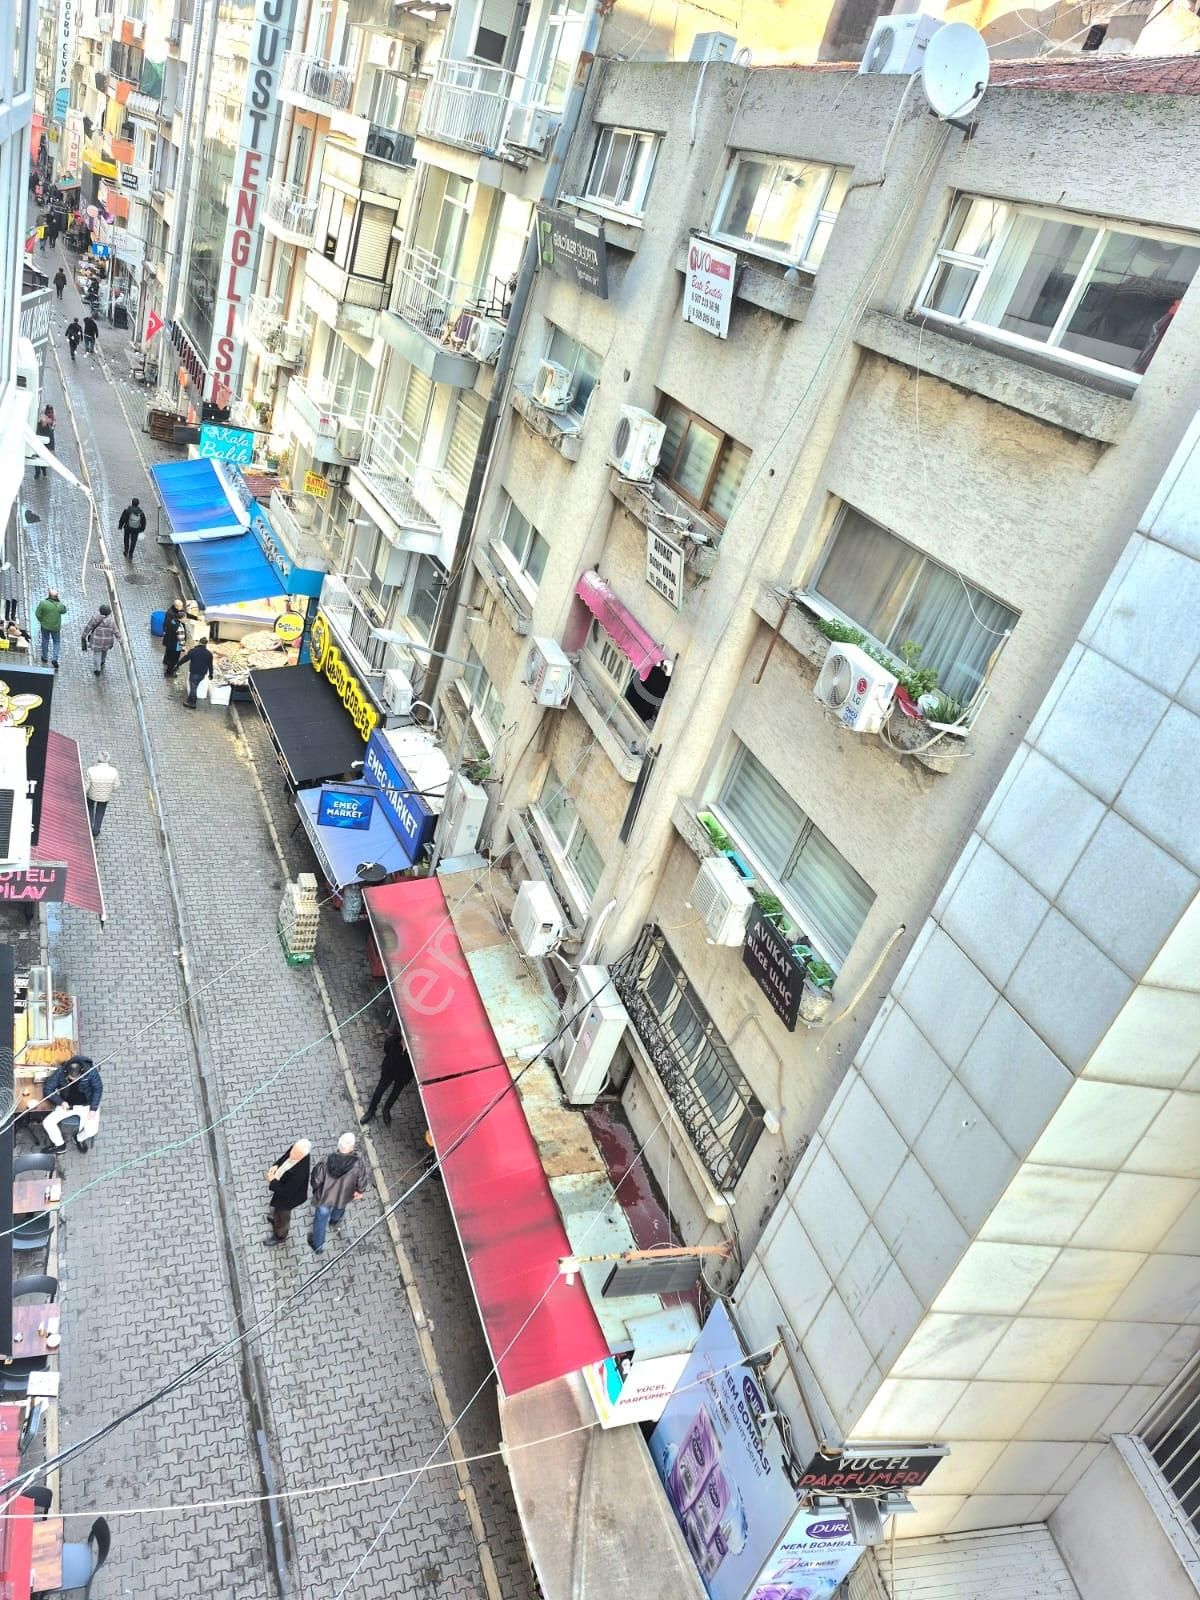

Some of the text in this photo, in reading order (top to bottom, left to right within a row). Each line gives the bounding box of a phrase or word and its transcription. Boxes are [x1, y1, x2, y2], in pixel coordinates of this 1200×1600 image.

[211, 0, 283, 402] JUST ENGLISH
[852, 694, 862, 706] LG
[326, 809, 363, 819] MARKET
[333, 801, 359, 811] EMEC
[386, 782, 418, 839] MARKET
[747, 934, 769, 971] BİLGE
[754, 921, 793, 976] AVUKAT
[737, 1399, 772, 1476] BOMBASI
[780, 1542, 808, 1551] NEM
